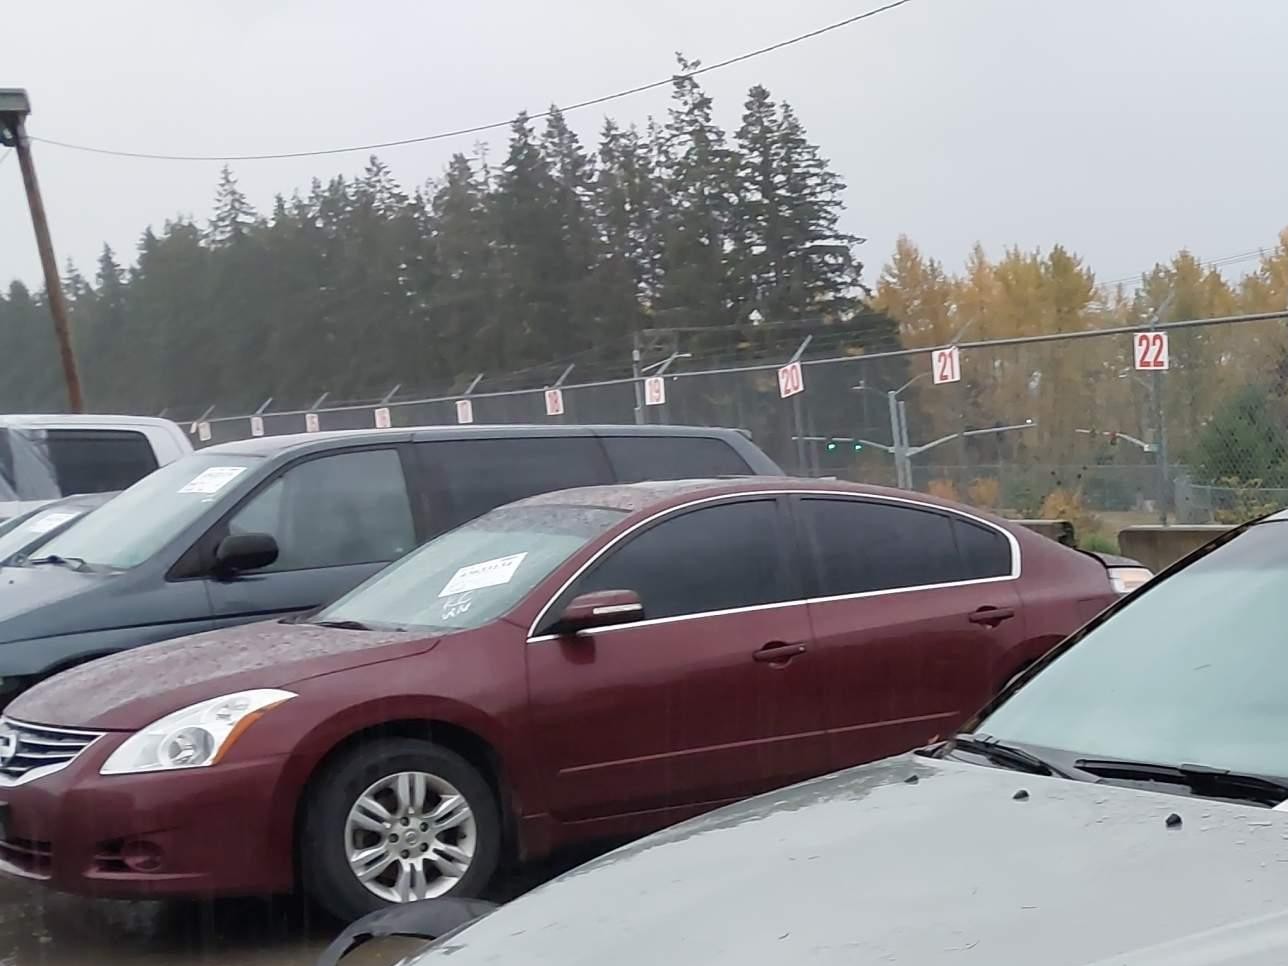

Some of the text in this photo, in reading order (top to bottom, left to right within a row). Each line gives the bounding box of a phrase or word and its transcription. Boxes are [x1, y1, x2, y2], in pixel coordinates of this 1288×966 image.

[937, 351, 957, 382] 21
[1137, 334, 1165, 368] 22
[780, 364, 800, 396] 20
